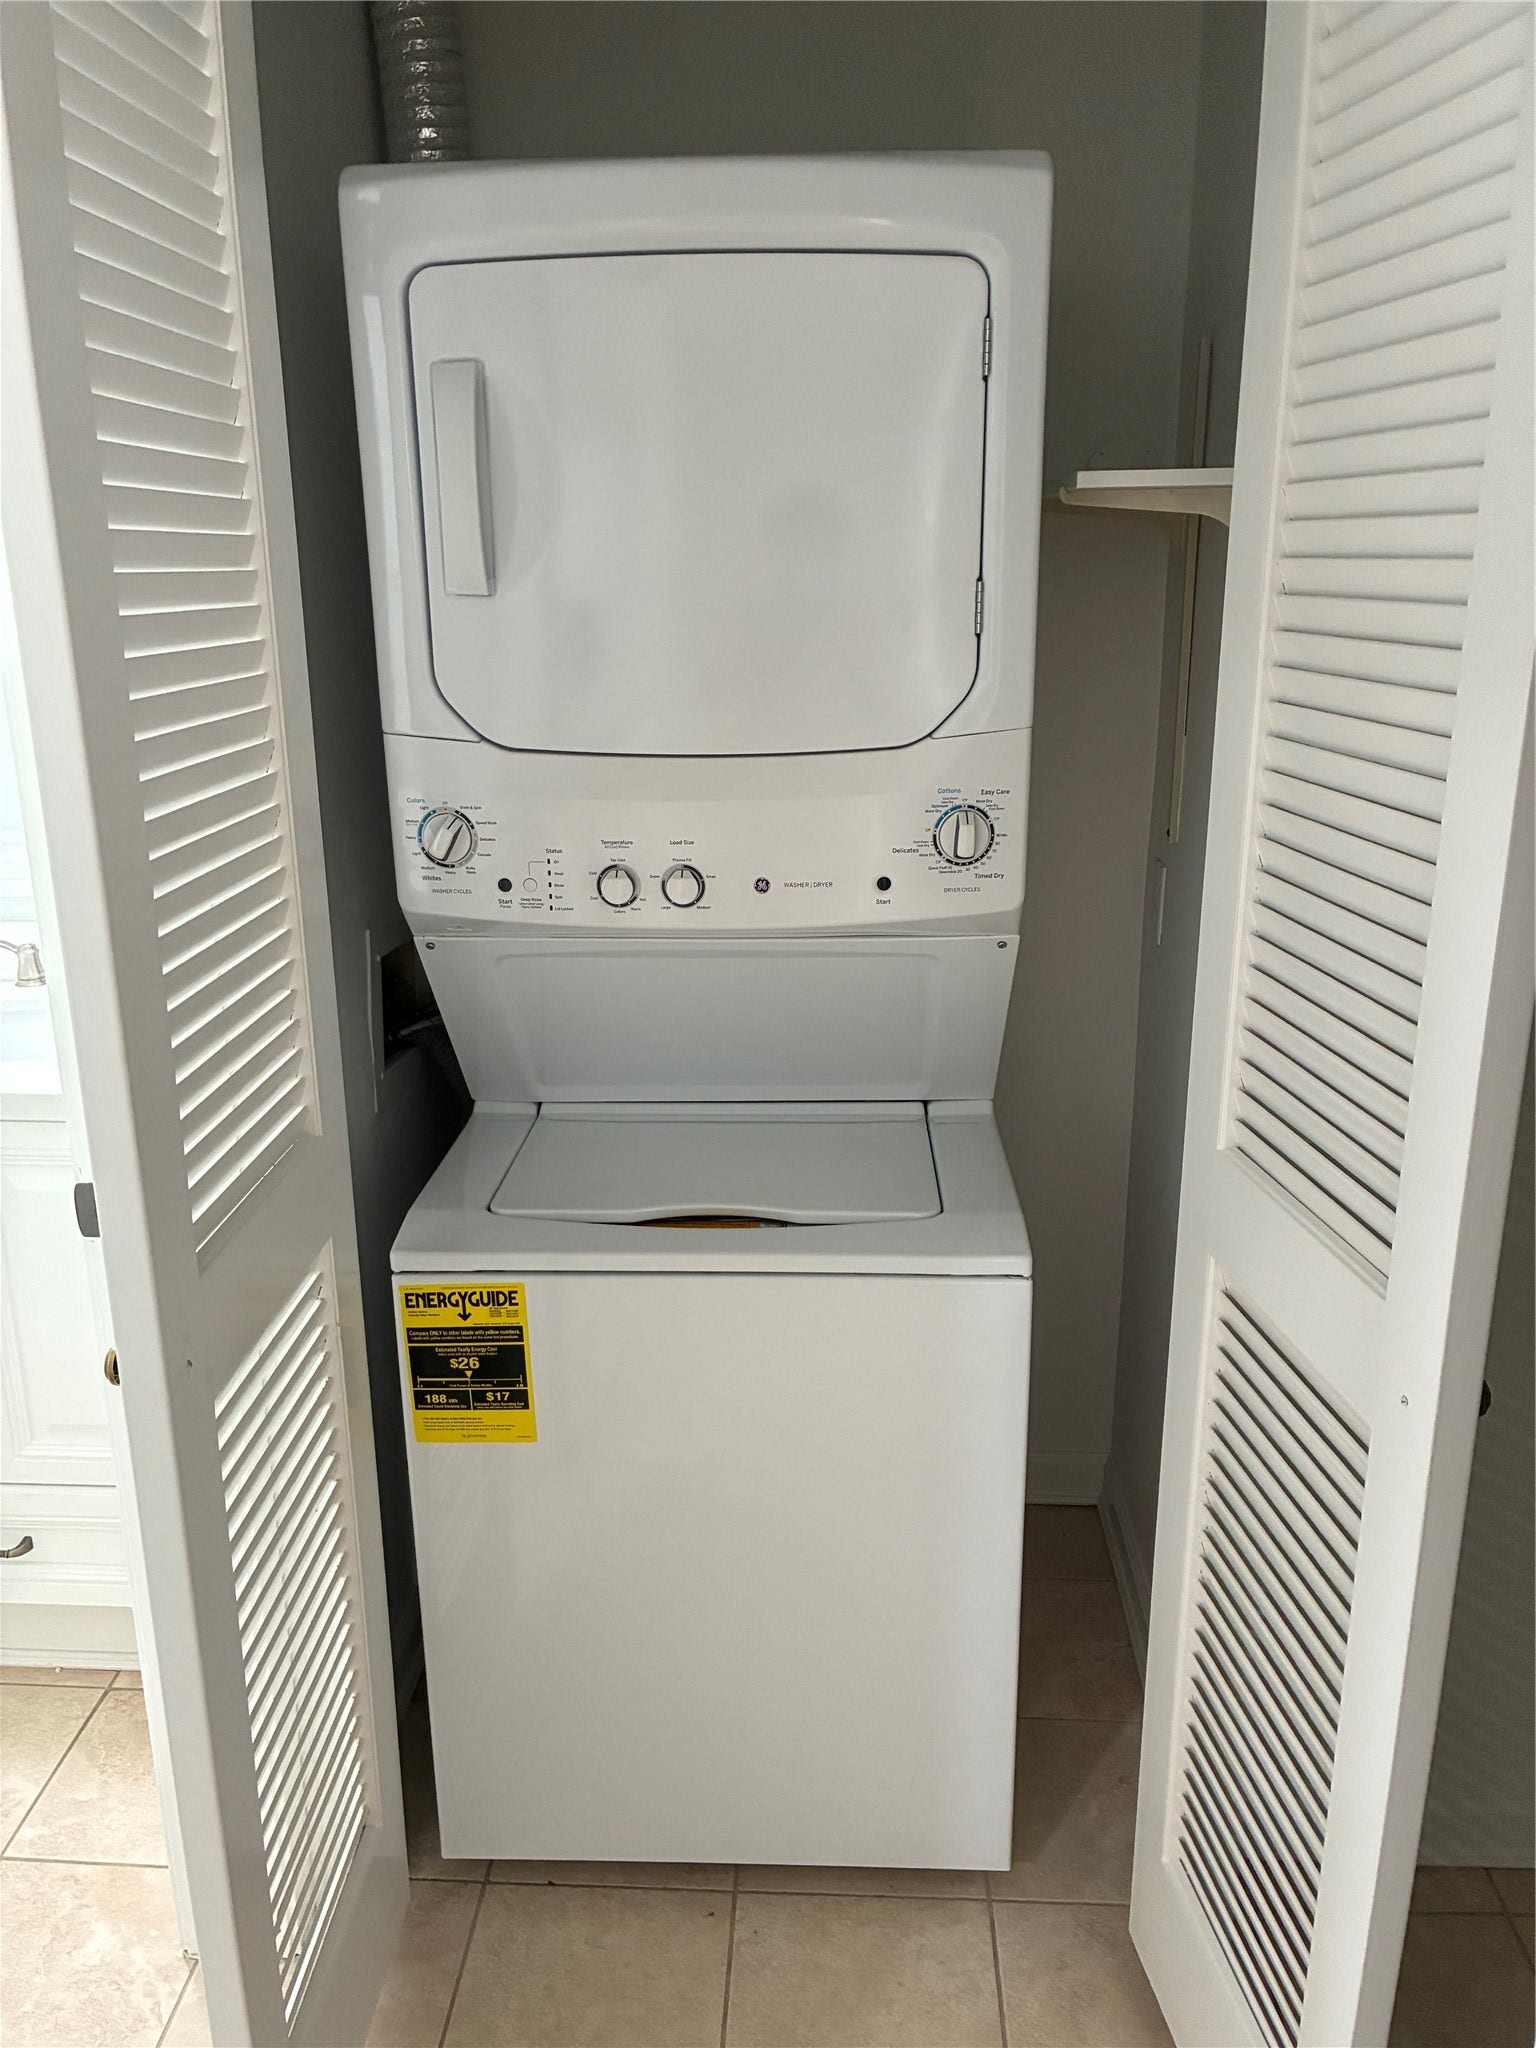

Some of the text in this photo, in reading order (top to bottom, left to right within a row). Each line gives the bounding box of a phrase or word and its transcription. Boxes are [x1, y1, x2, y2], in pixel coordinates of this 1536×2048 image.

[404, 1290, 519, 1309] ENERGYGUIDE
[449, 1357, 480, 1369] $26
[424, 1394, 447, 1404] 188
[486, 1391, 510, 1402] $17
